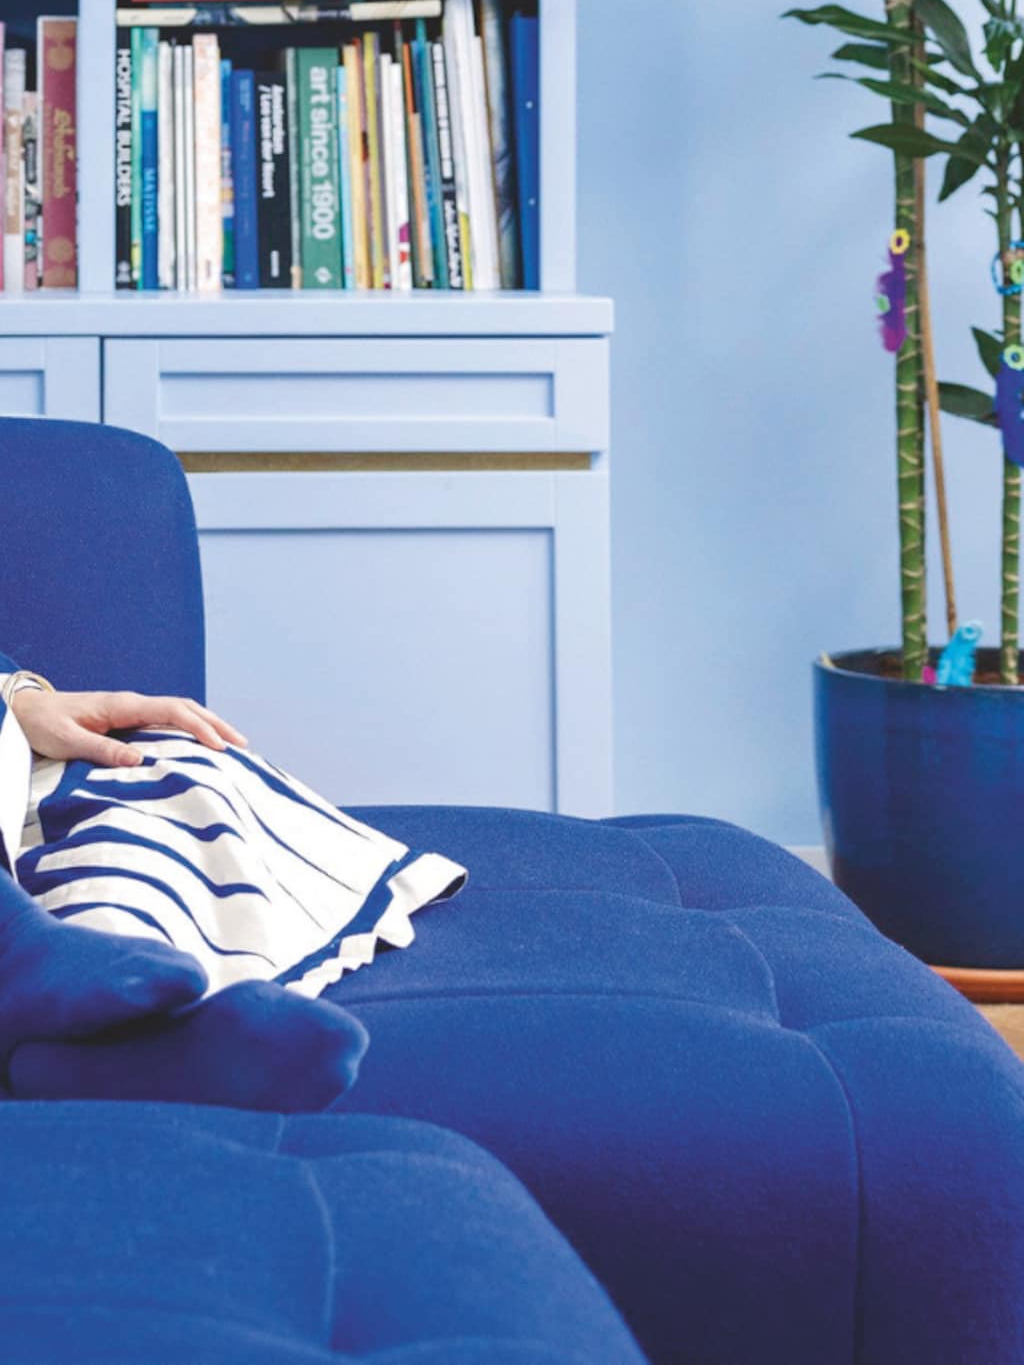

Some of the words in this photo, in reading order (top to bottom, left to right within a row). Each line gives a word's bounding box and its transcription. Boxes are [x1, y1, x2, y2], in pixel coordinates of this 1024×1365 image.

[117, 47, 132, 126] HOSPITAL
[308, 67, 330, 104] art
[117, 129, 132, 207] BUILDERS
[310, 108, 333, 177] since
[312, 181, 336, 240] 1900
